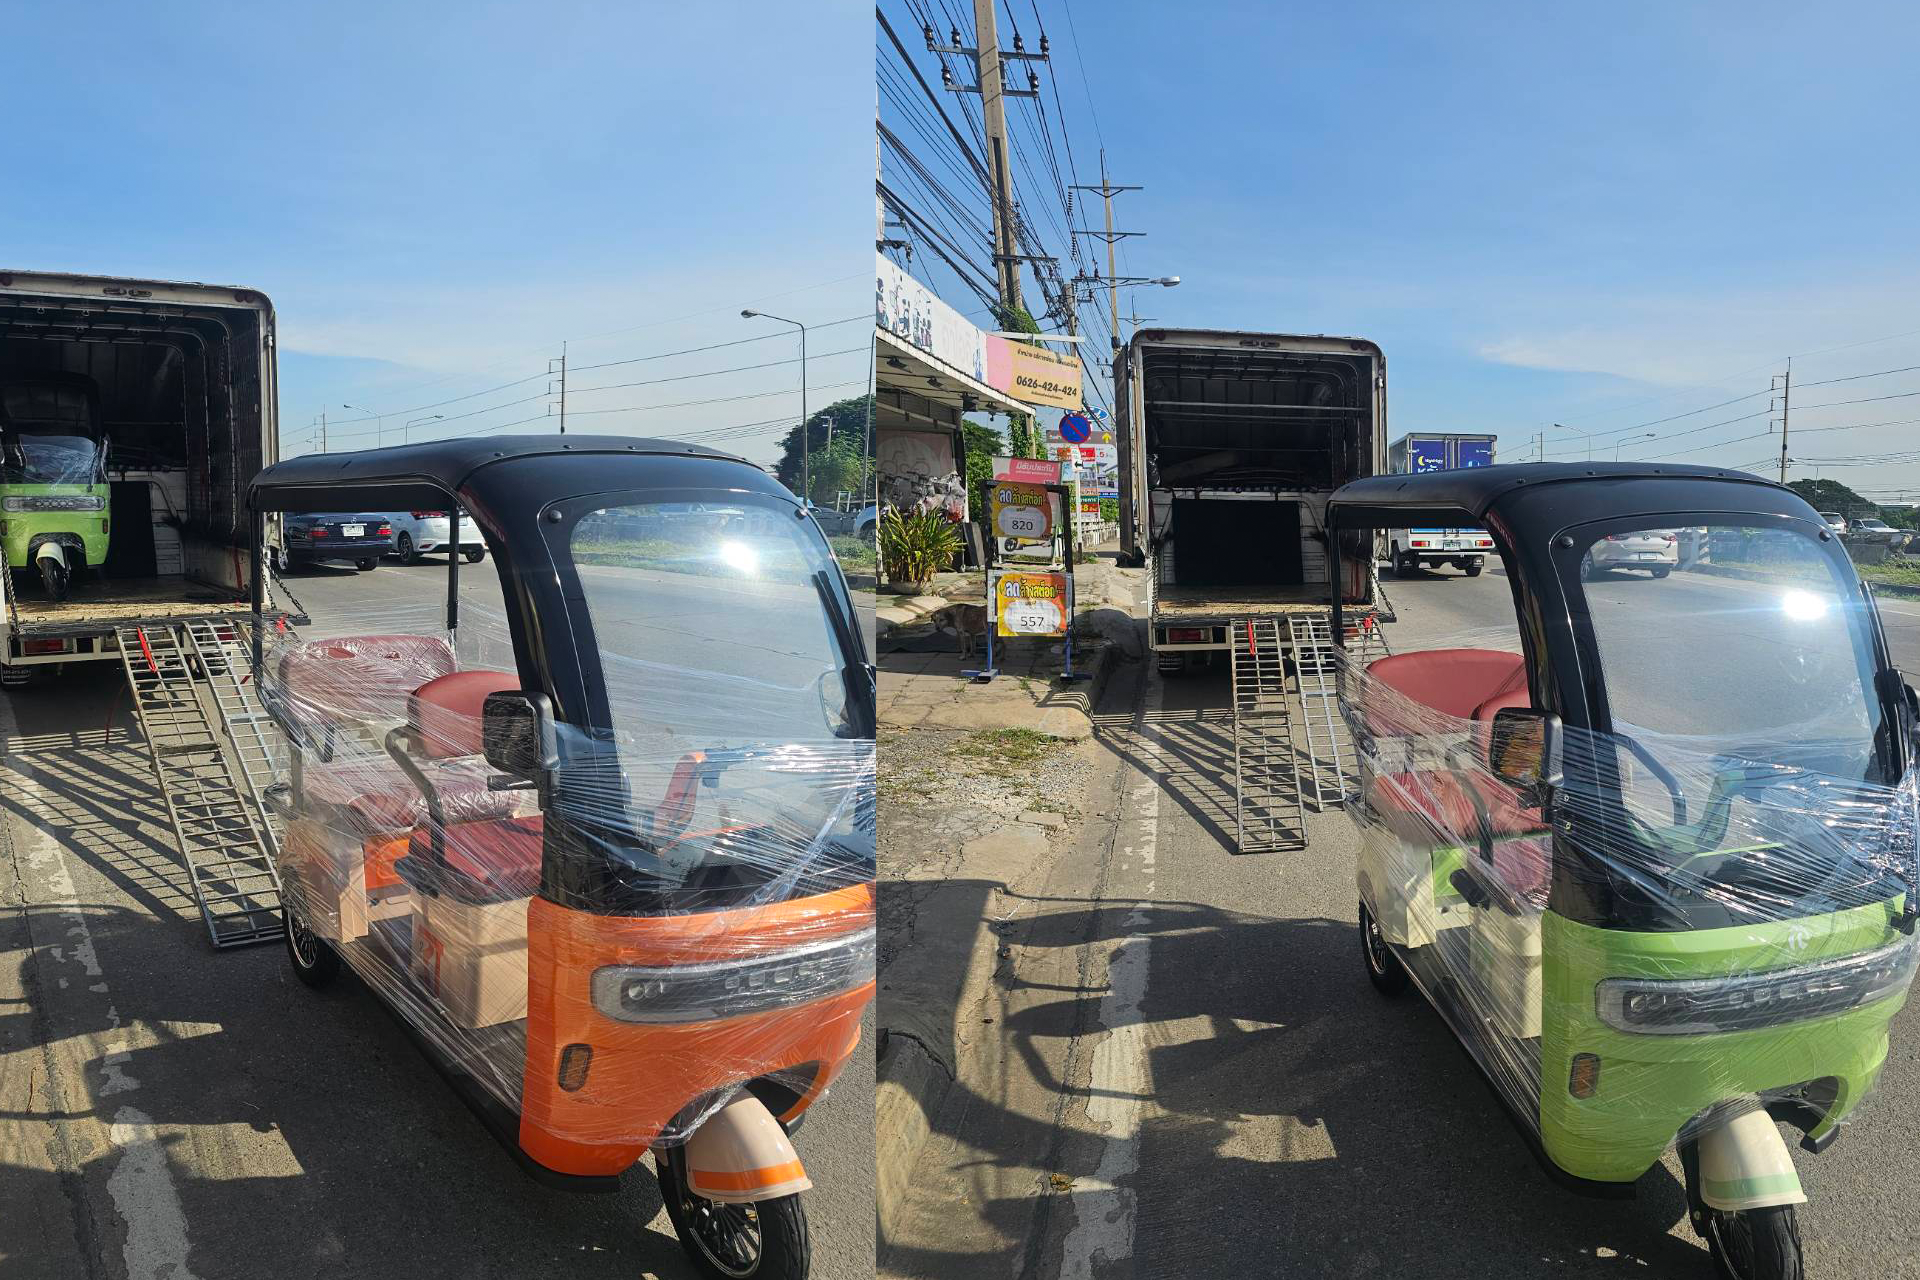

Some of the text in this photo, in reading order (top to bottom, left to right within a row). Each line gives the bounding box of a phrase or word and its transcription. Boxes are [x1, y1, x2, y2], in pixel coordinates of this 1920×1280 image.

[1016, 375, 1077, 397] 0626-424-424
[1011, 520, 1033, 531] 820
[1020, 616, 1044, 627] 557
